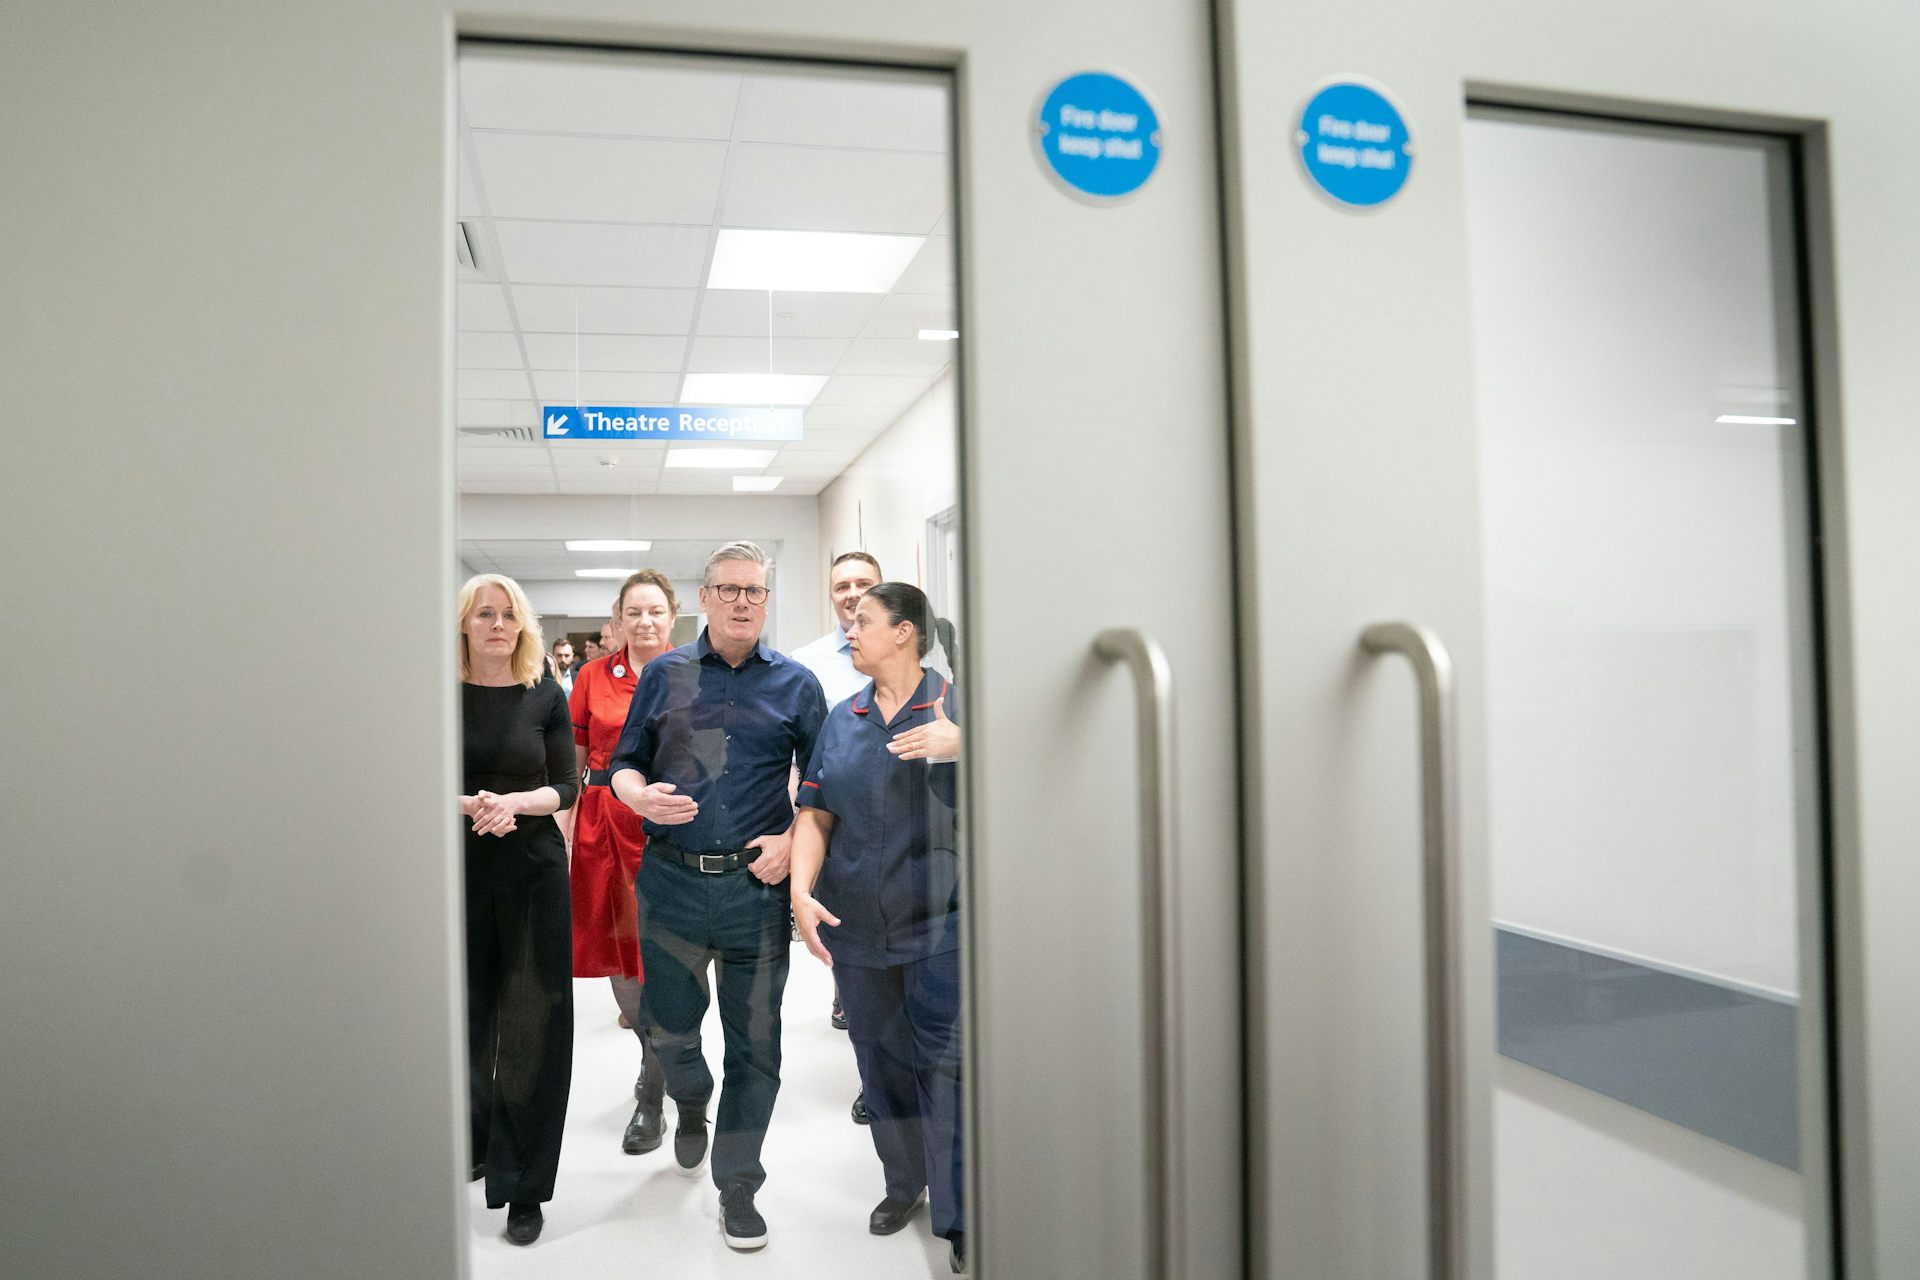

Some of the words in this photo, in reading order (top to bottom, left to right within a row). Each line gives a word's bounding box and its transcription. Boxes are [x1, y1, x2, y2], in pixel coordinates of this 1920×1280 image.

[1060, 105, 1095, 127] Fire
[1319, 115, 1351, 138] Fire
[1059, 135, 1100, 158] keep
[1318, 144, 1356, 168] keep
[584, 412, 670, 432] Theatre
[679, 413, 784, 435] Reception
